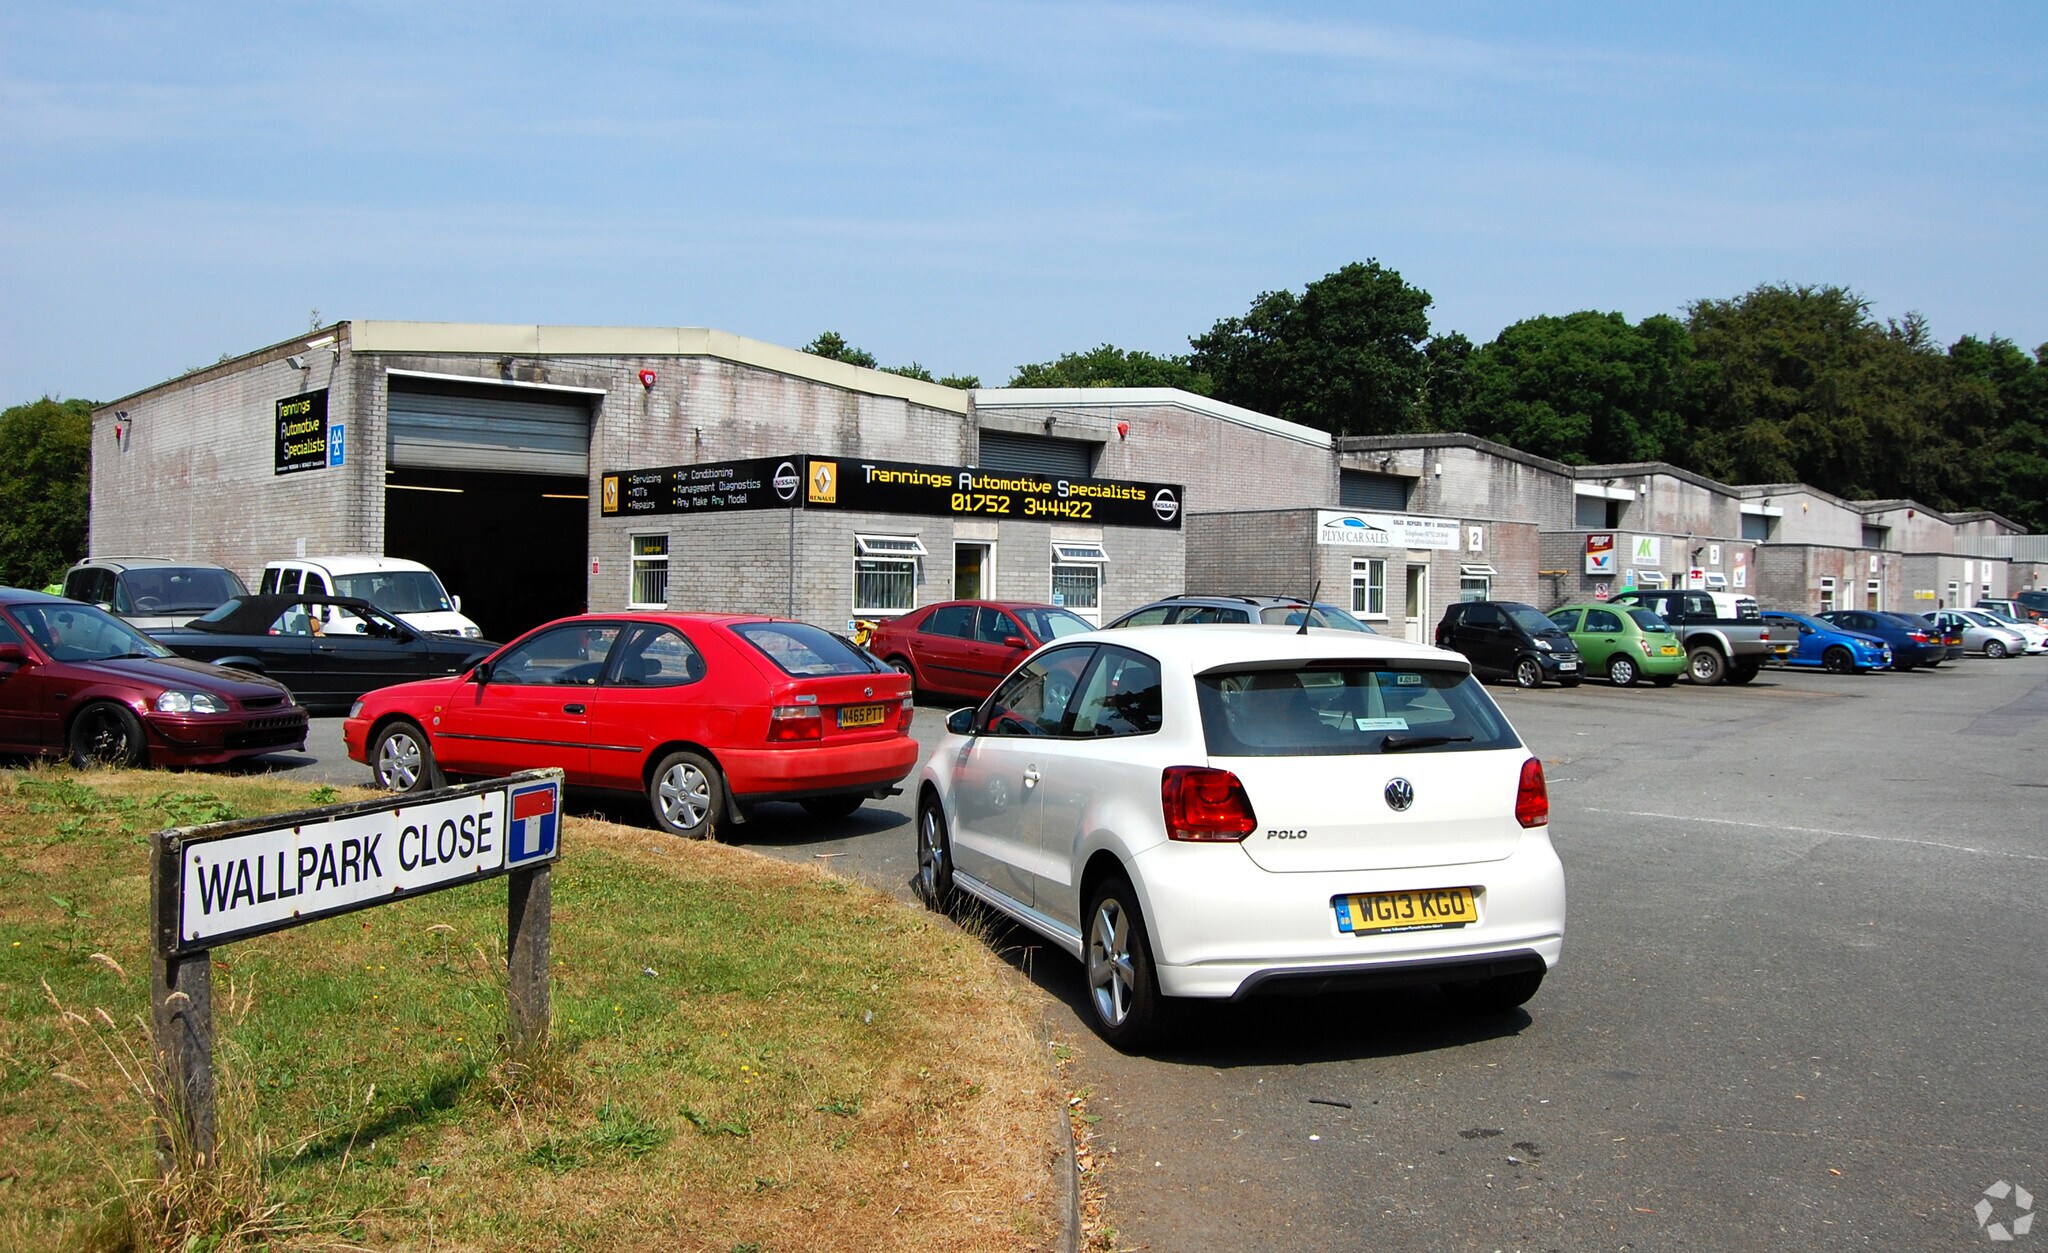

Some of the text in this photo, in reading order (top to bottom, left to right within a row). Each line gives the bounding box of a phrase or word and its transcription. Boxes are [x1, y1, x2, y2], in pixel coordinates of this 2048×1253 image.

[278, 400, 311, 420] Trannings
[281, 418, 320, 440] Automotive
[283, 437, 325, 460] Specialists
[632, 474, 662, 485] Servicing
[691, 468, 734, 480] Conditioning
[677, 480, 761, 495] Management Diagnostics
[774, 478, 798, 486] NISSAN
[861, 464, 1146, 500] Trannings Automotive Specialists
[632, 501, 655, 511] Repairs
[677, 493, 747, 508] Any Make Any Model
[951, 493, 1092, 518] 01752 344422
[1154, 502, 1178, 510] NISSAN
[1322, 530, 1389, 544] PLYM CAR SALES
[1472, 532, 1479, 546] 2
[843, 707, 883, 724] N465 PTT
[1266, 830, 1308, 840] POLO
[196, 811, 494, 916] WALLPARK CLOSE
[1357, 893, 1414, 922] WG13
